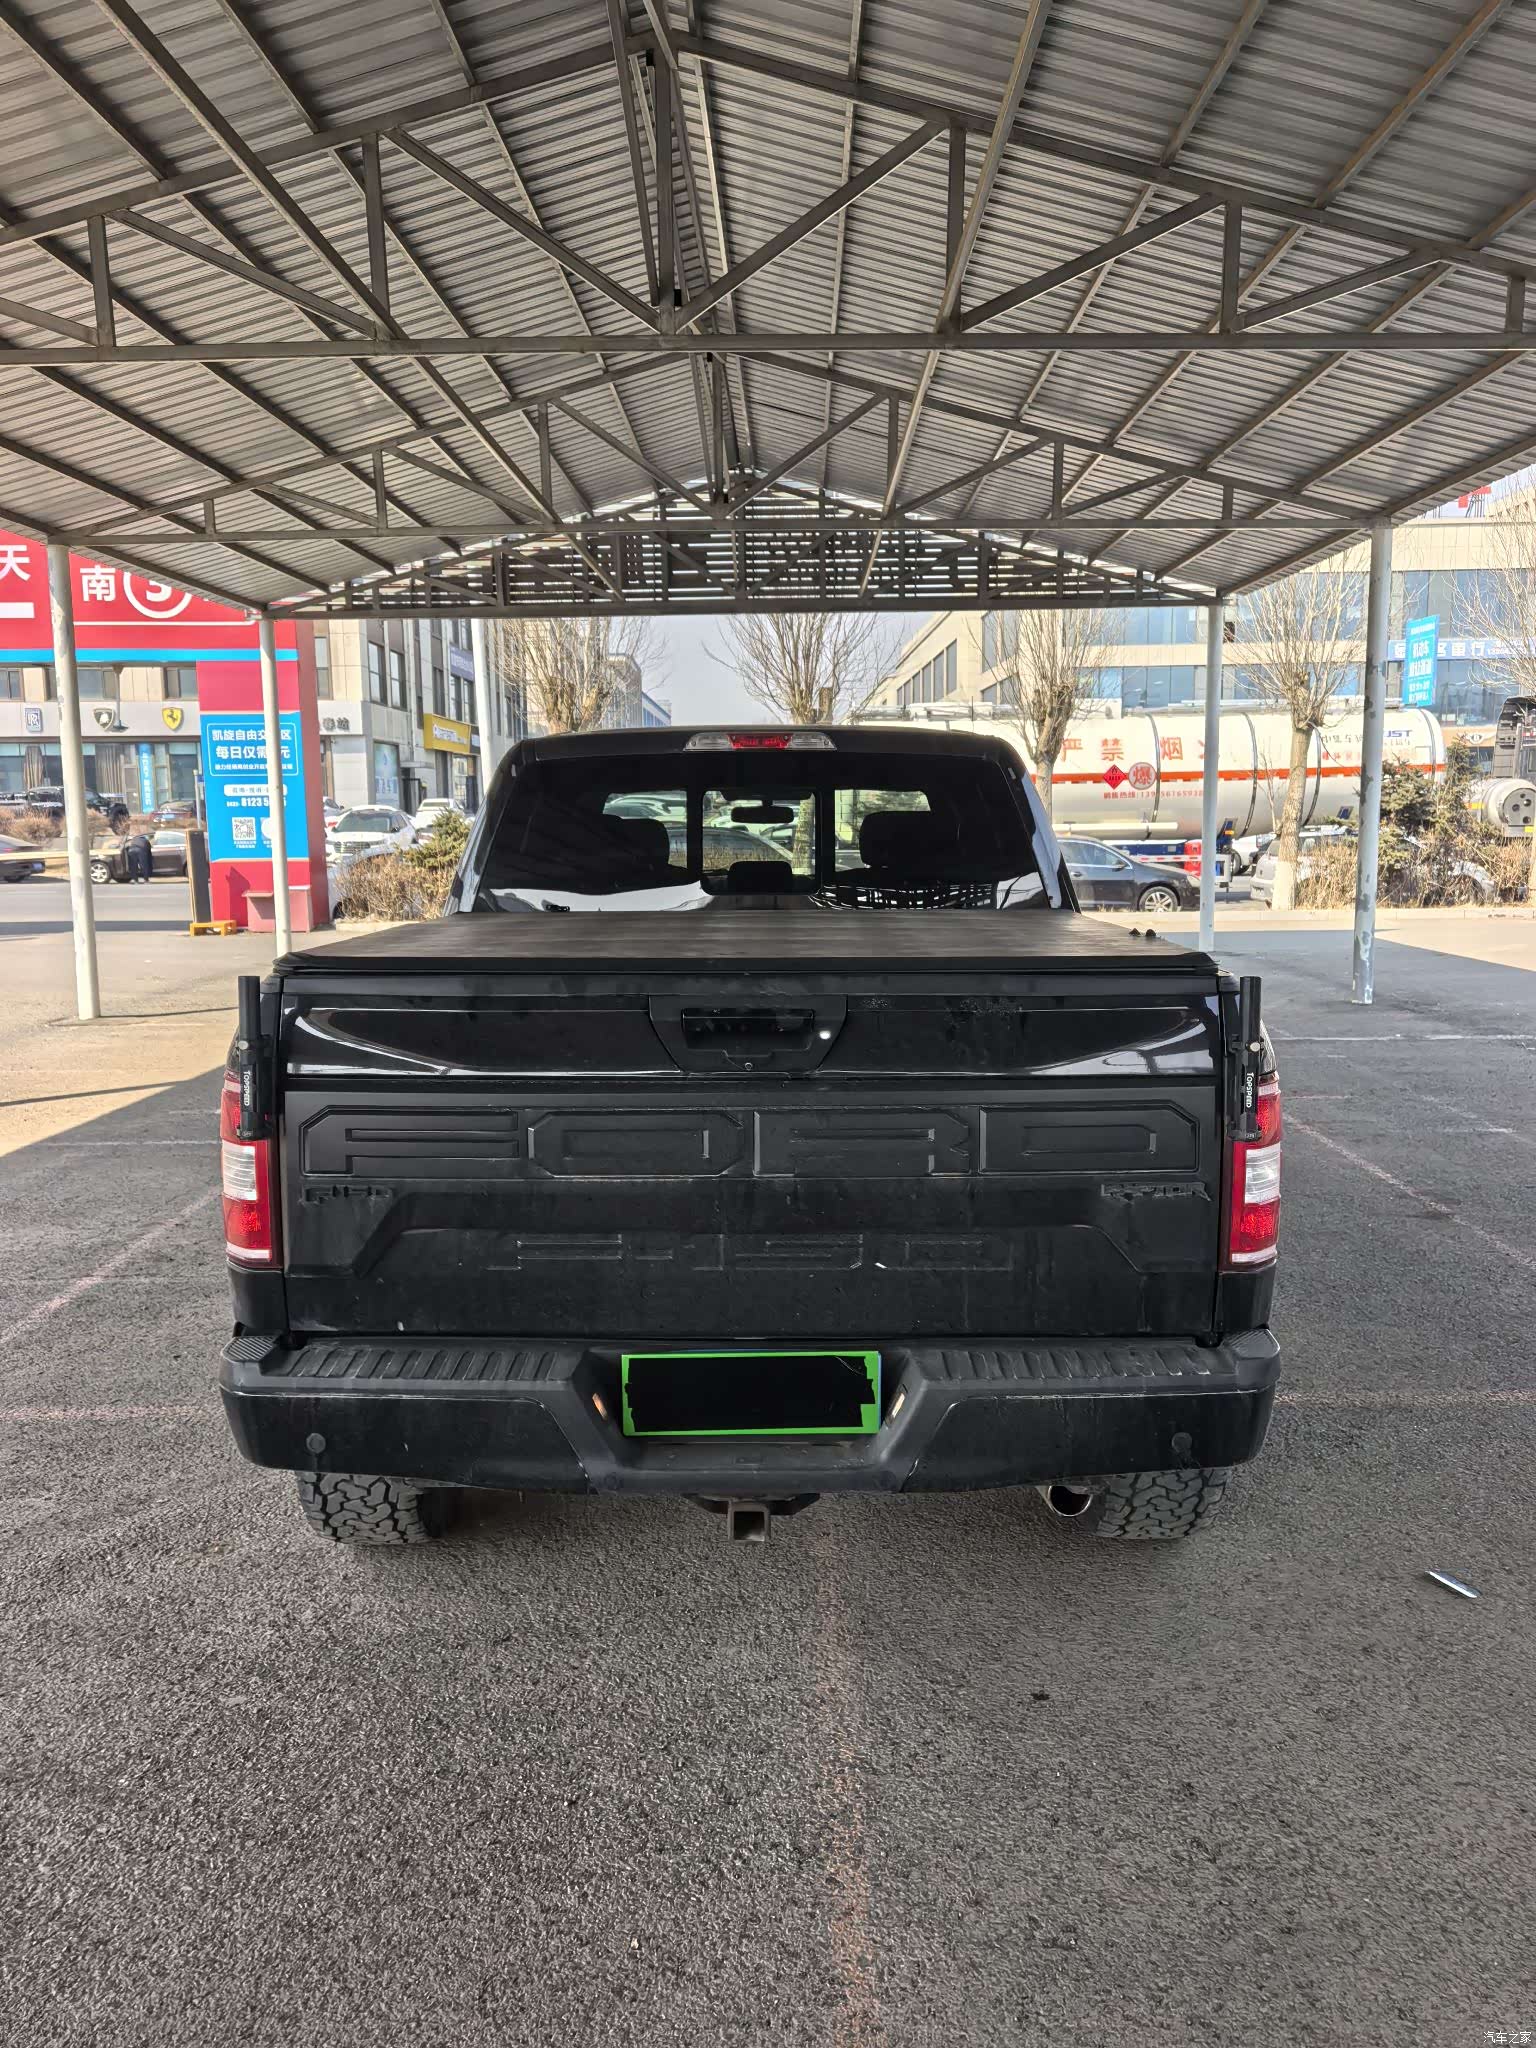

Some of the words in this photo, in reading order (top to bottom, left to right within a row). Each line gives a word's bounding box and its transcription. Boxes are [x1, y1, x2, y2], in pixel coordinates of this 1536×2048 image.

[80, 565, 116, 602] 南
[212, 729, 292, 741] 凯旋自由交区
[215, 745, 291, 759] 每日仅需元
[243, 1070, 251, 1106] TOPSPEED
[1246, 1072, 1254, 1108] TOPSPEED
[300, 1106, 1199, 1178] FORD
